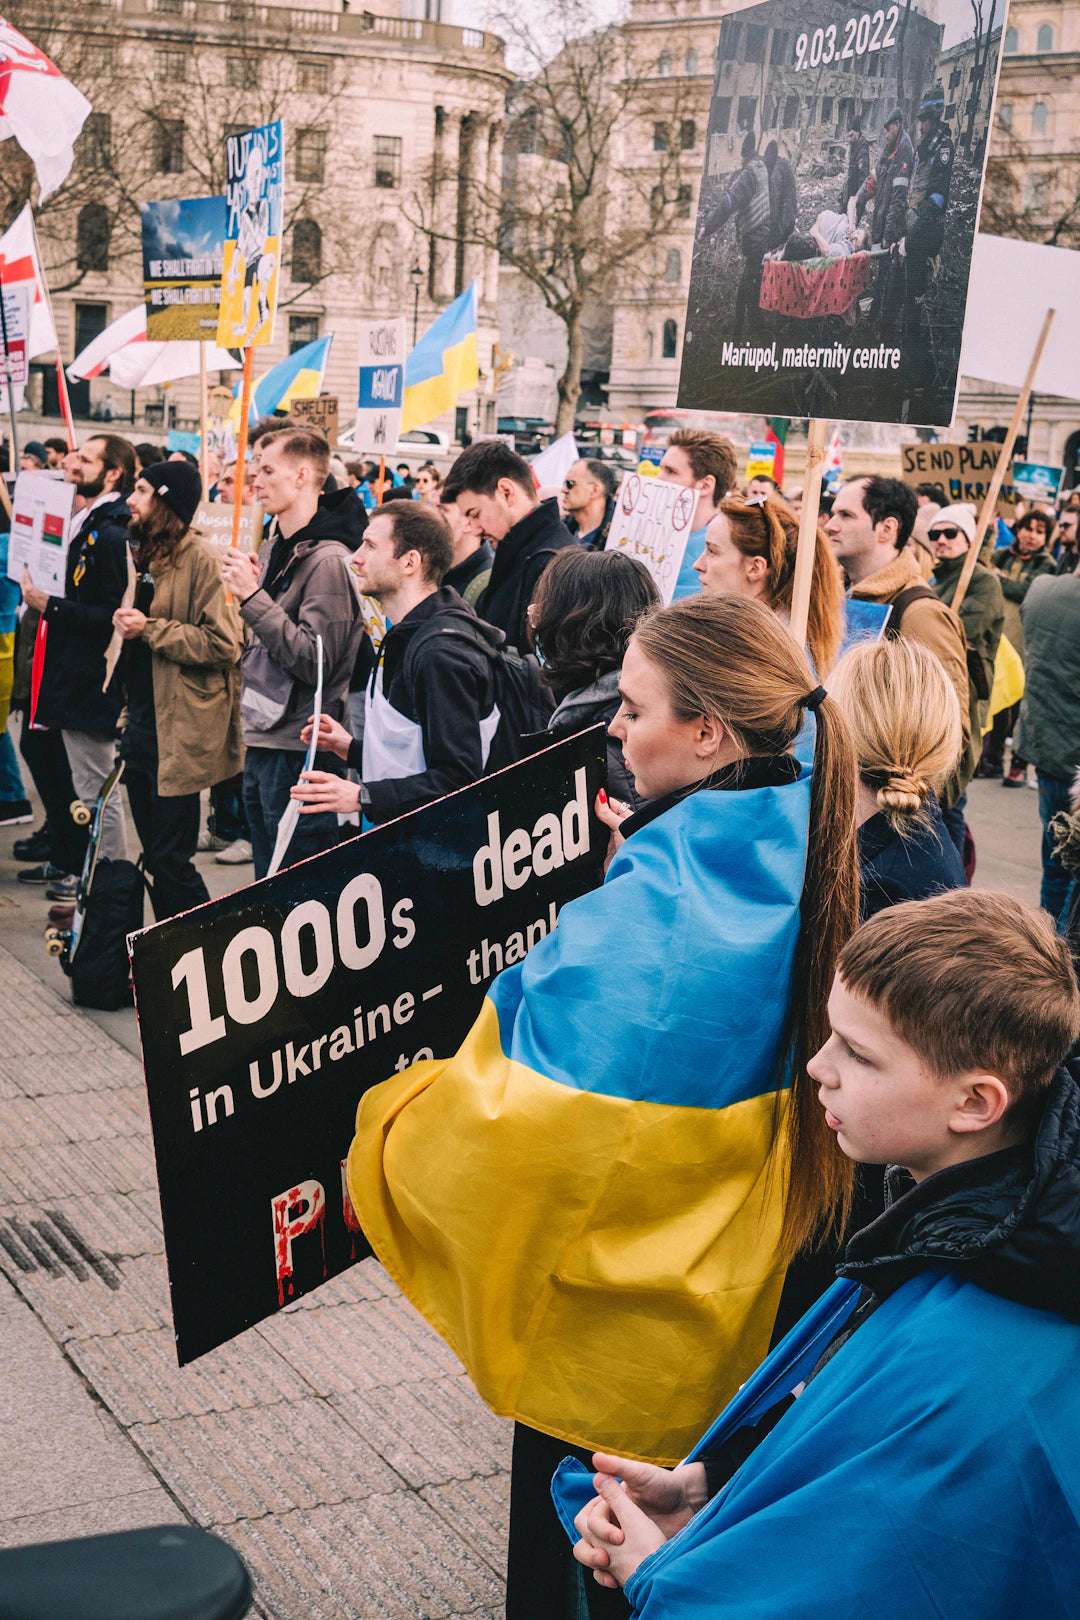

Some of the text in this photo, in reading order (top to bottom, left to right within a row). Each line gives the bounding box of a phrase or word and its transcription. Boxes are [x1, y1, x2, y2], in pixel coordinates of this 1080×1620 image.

[795, 5, 899, 72] 9.03.2022
[721, 341, 901, 375] Mariupol, maternity centre
[293, 400, 338, 417] SHELTER
[904, 447, 954, 473] SEND
[171, 767, 591, 1056] 1000s dead
[189, 1082, 235, 1133] in
[249, 990, 415, 1099] Ukraine
